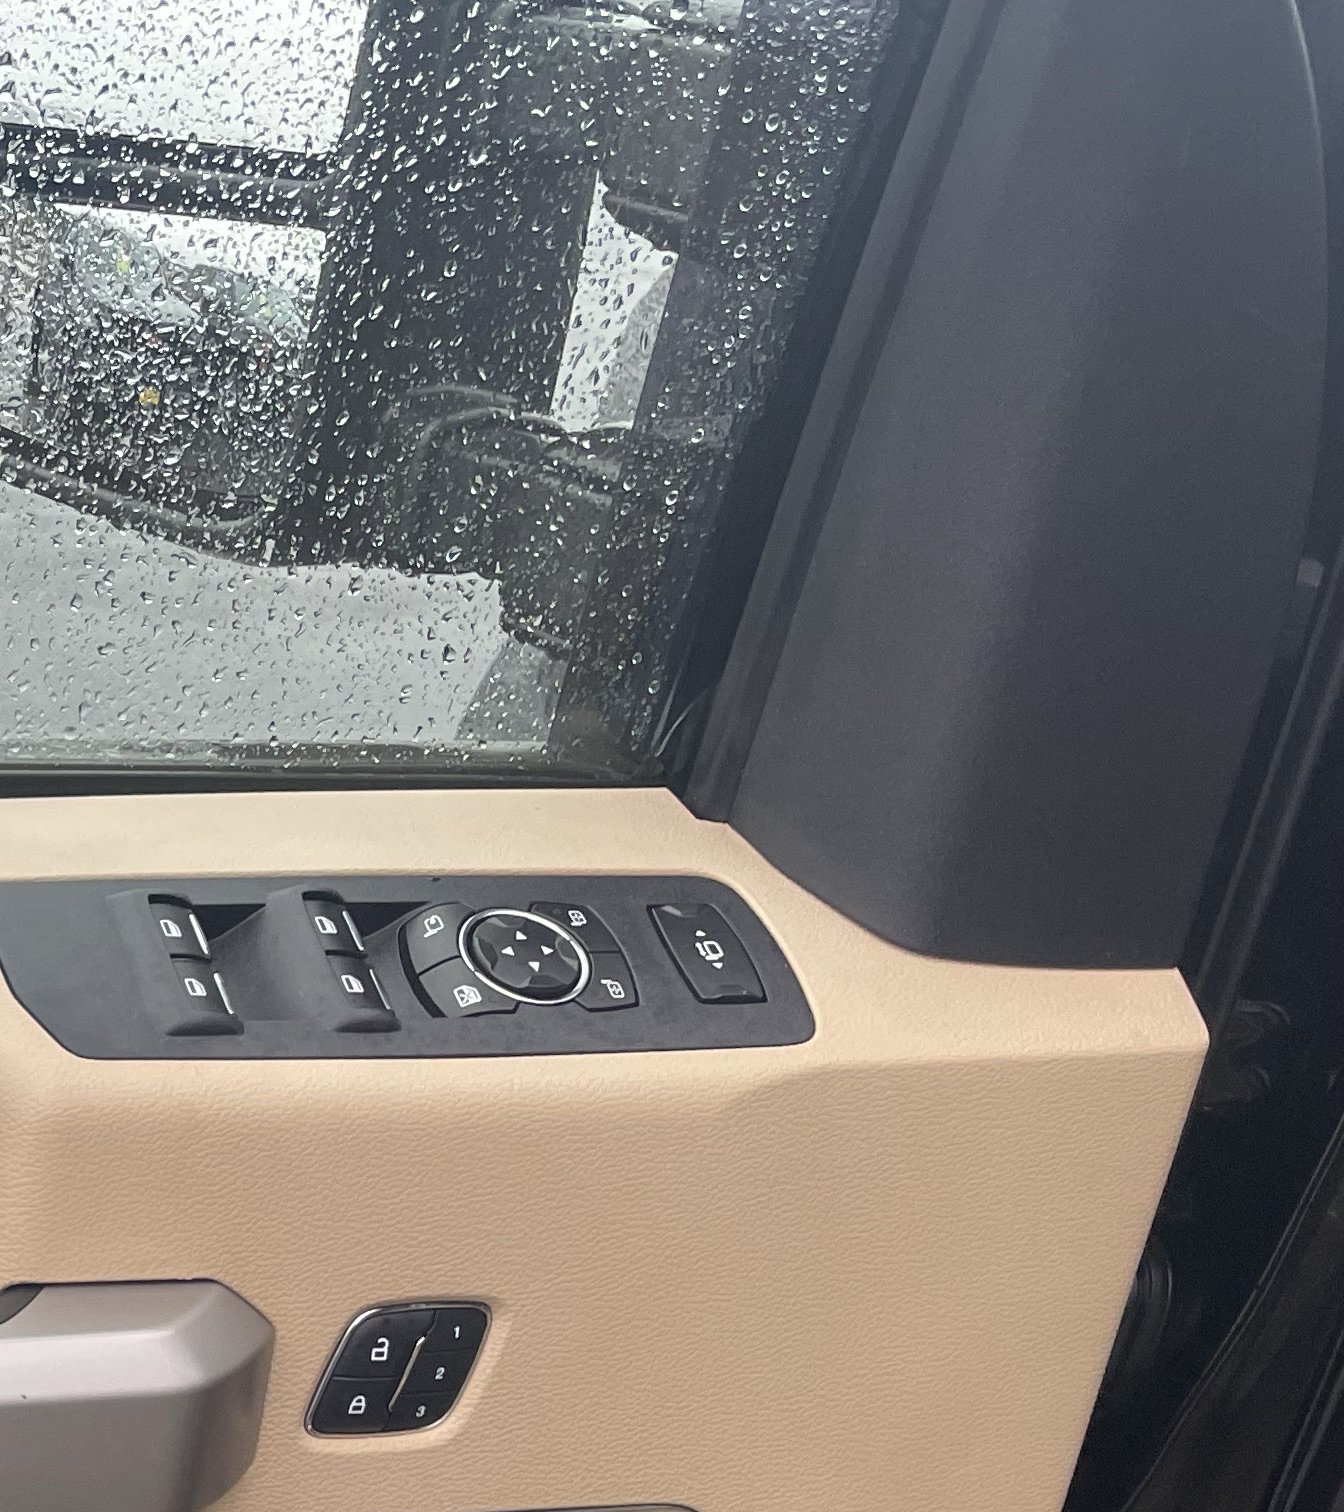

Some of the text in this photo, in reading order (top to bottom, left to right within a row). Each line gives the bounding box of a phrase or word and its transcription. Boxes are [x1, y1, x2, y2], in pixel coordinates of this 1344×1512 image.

[454, 1326, 460, 1339] 1
[435, 1367, 445, 1380] 2
[416, 1405, 426, 1417] 3
